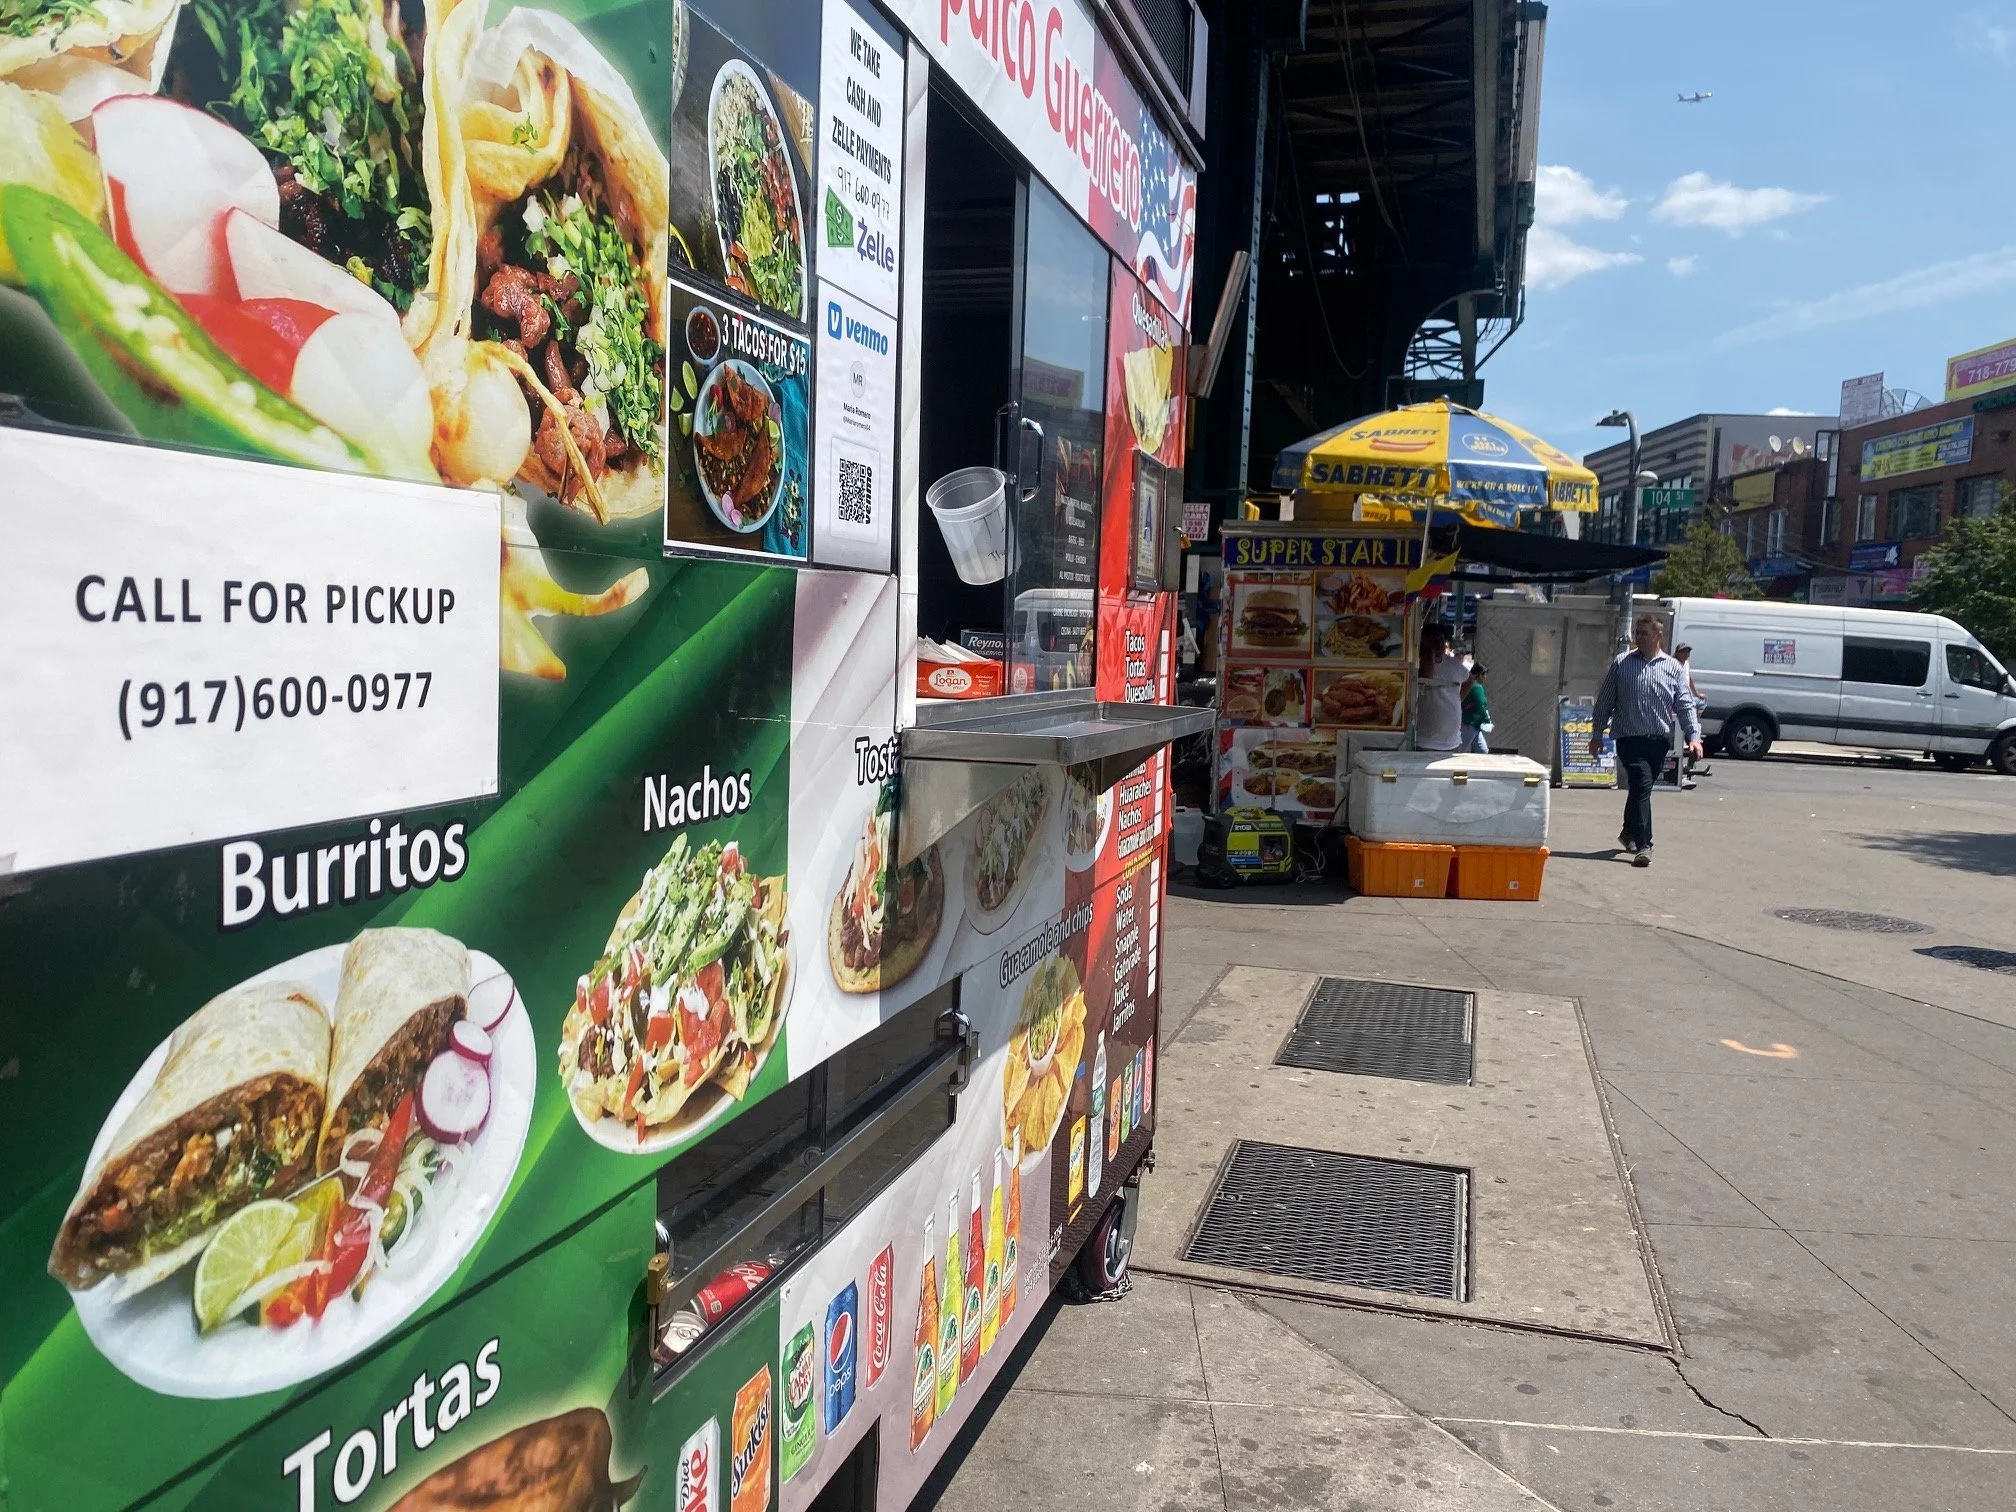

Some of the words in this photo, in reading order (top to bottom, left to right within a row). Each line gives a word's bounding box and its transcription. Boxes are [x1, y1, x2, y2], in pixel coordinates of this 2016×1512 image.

[850, 27, 861, 62] WE
[863, 38, 881, 79] TAKE
[846, 76, 866, 116] CASH
[866, 94, 882, 128] AND
[1045, 7, 1142, 232] Guerrero
[832, 115, 855, 157] ZELLE
[856, 134, 892, 184] PAYMENTS
[837, 166, 851, 194] 917
[857, 217, 895, 273] Zelle
[722, 313, 729, 346] 3
[731, 317, 766, 360] TACOS
[768, 333, 787, 370] FOR
[789, 342, 806, 376] $15
[845, 316, 888, 356] venmo
[852, 372, 863, 387] MR
[855, 406, 871, 420] Romero
[1350, 428, 1440, 441] SABRETT
[1311, 462, 1436, 488] SABRETT
[1484, 480, 1496, 490] ON
[1498, 482, 1504, 491] A
[1506, 483, 1525, 492] ROLL
[1552, 480, 1592, 503] ABRETT
[865, 466, 873, 525] venmo
[1651, 490, 1671, 506] 104
[1236, 538, 1316, 565] SUPER
[1321, 538, 1388, 565] STAR
[1395, 538, 1410, 565] II
[76, 575, 202, 623] CALL
[223, 580, 307, 623] FOR
[327, 584, 456, 624] PICKUP
[1125, 630, 1145, 652] Tacos
[934, 673, 967, 687] Logan
[1125, 656, 1146, 678] Tortas
[118, 671, 433, 741] (917)600-0977
[643, 764, 751, 832] Nachos
[1119, 777, 1152, 807] Huaraches
[1118, 806, 1142, 832] Nachos
[221, 818, 468, 928] Burritos
[1116, 880, 1133, 908] Soda
[1115, 905, 1135, 933] Water
[999, 921, 1053, 989] Guacamole
[1052, 909, 1071, 949] and
[1072, 901, 1094, 933] chips
[1115, 923, 1140, 958] Snapple
[1114, 943, 1142, 984] Gatorade
[1113, 980, 1130, 1010] Juice
[1111, 999, 1136, 1036] Jarritos
[872, 1262, 887, 1369] Coca-Cola
[829, 1362, 852, 1397] pepsi
[283, 1337, 501, 1512] Tortas
[733, 1394, 769, 1498] Sunkist
[680, 1459, 689, 1511] Diet
